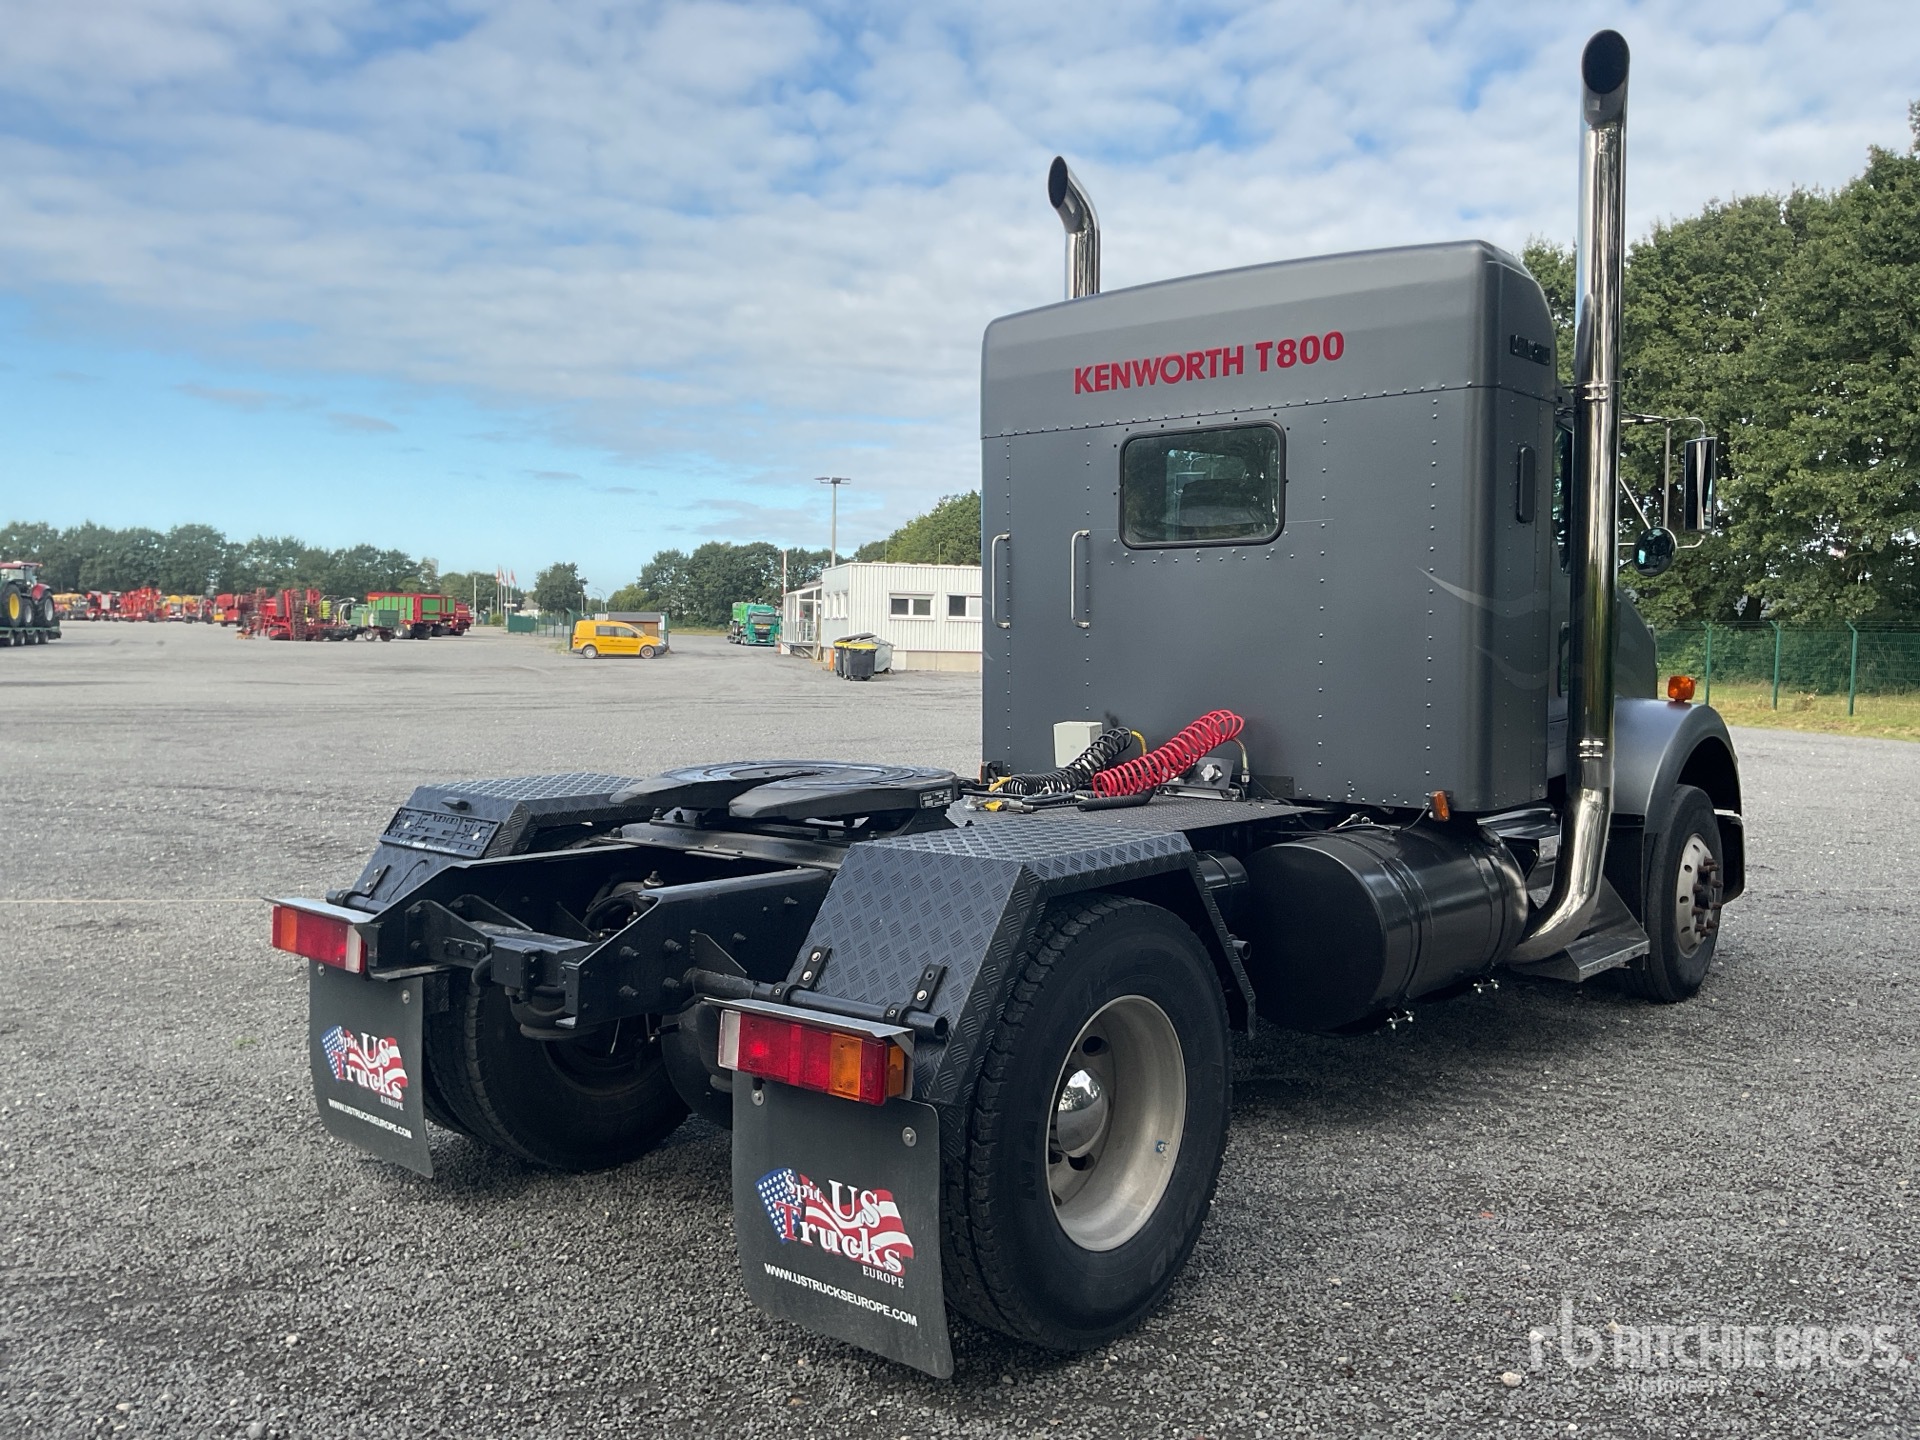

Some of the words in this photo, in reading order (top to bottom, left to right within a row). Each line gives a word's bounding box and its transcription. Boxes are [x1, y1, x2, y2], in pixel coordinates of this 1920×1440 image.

[1074, 345, 1244, 395] KENWORTH
[1255, 331, 1345, 372] T800
[330, 1049, 403, 1101] Trucks
[361, 1031, 390, 1068] US
[785, 1173, 824, 1204] Spit
[828, 1179, 881, 1229] US
[775, 1200, 905, 1275] Trucks
[763, 1262, 918, 1327] WWW.USTRUCKSEUROPE.COM
[862, 1265, 905, 1289] EUROPE
